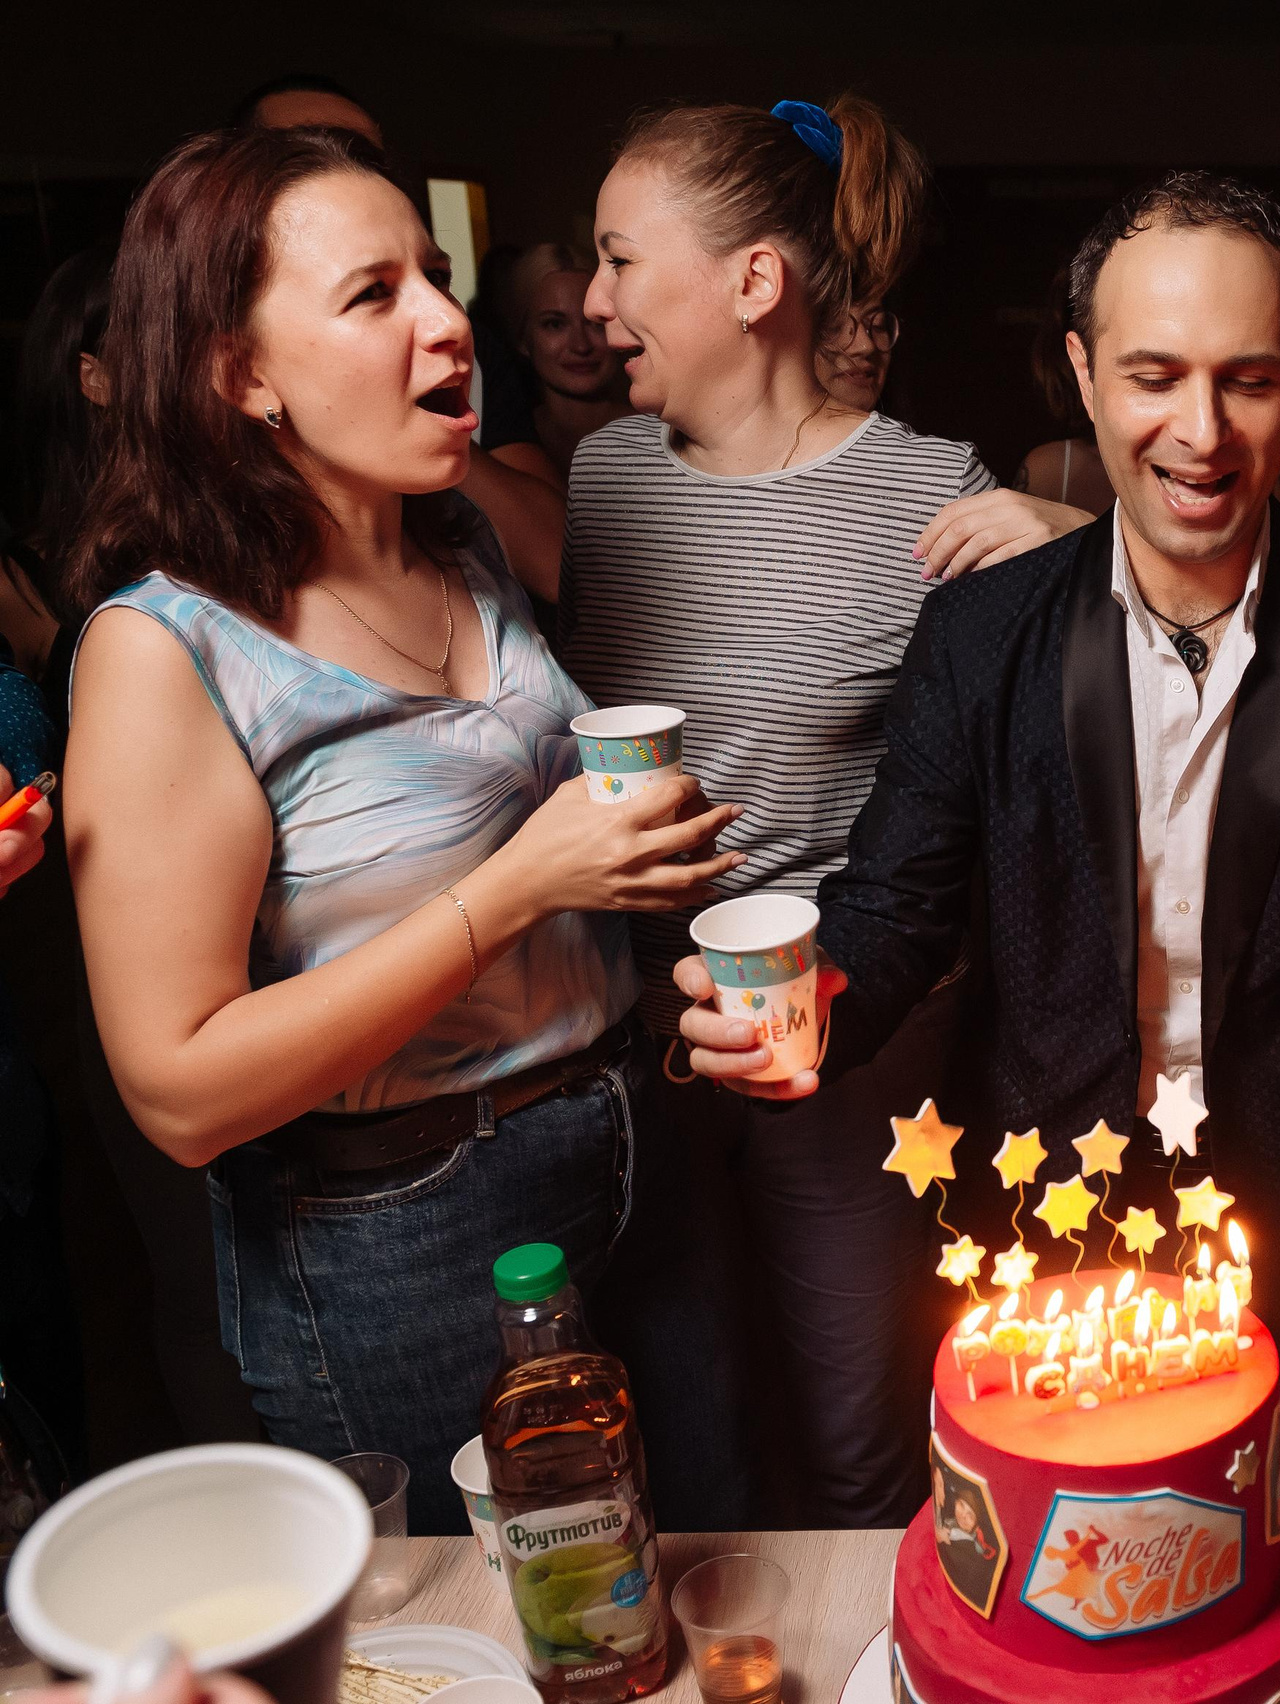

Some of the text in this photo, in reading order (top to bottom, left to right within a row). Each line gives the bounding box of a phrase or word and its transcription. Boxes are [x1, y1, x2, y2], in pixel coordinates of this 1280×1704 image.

[754, 1004, 807, 1042] НЕМ
[506, 1513, 623, 1551] Фрутмотив
[1104, 1523, 1194, 1566] Noche
[1082, 1527, 1241, 1630] Salsa
[1147, 1548, 1182, 1578] de
[564, 1660, 623, 1682] яблока
